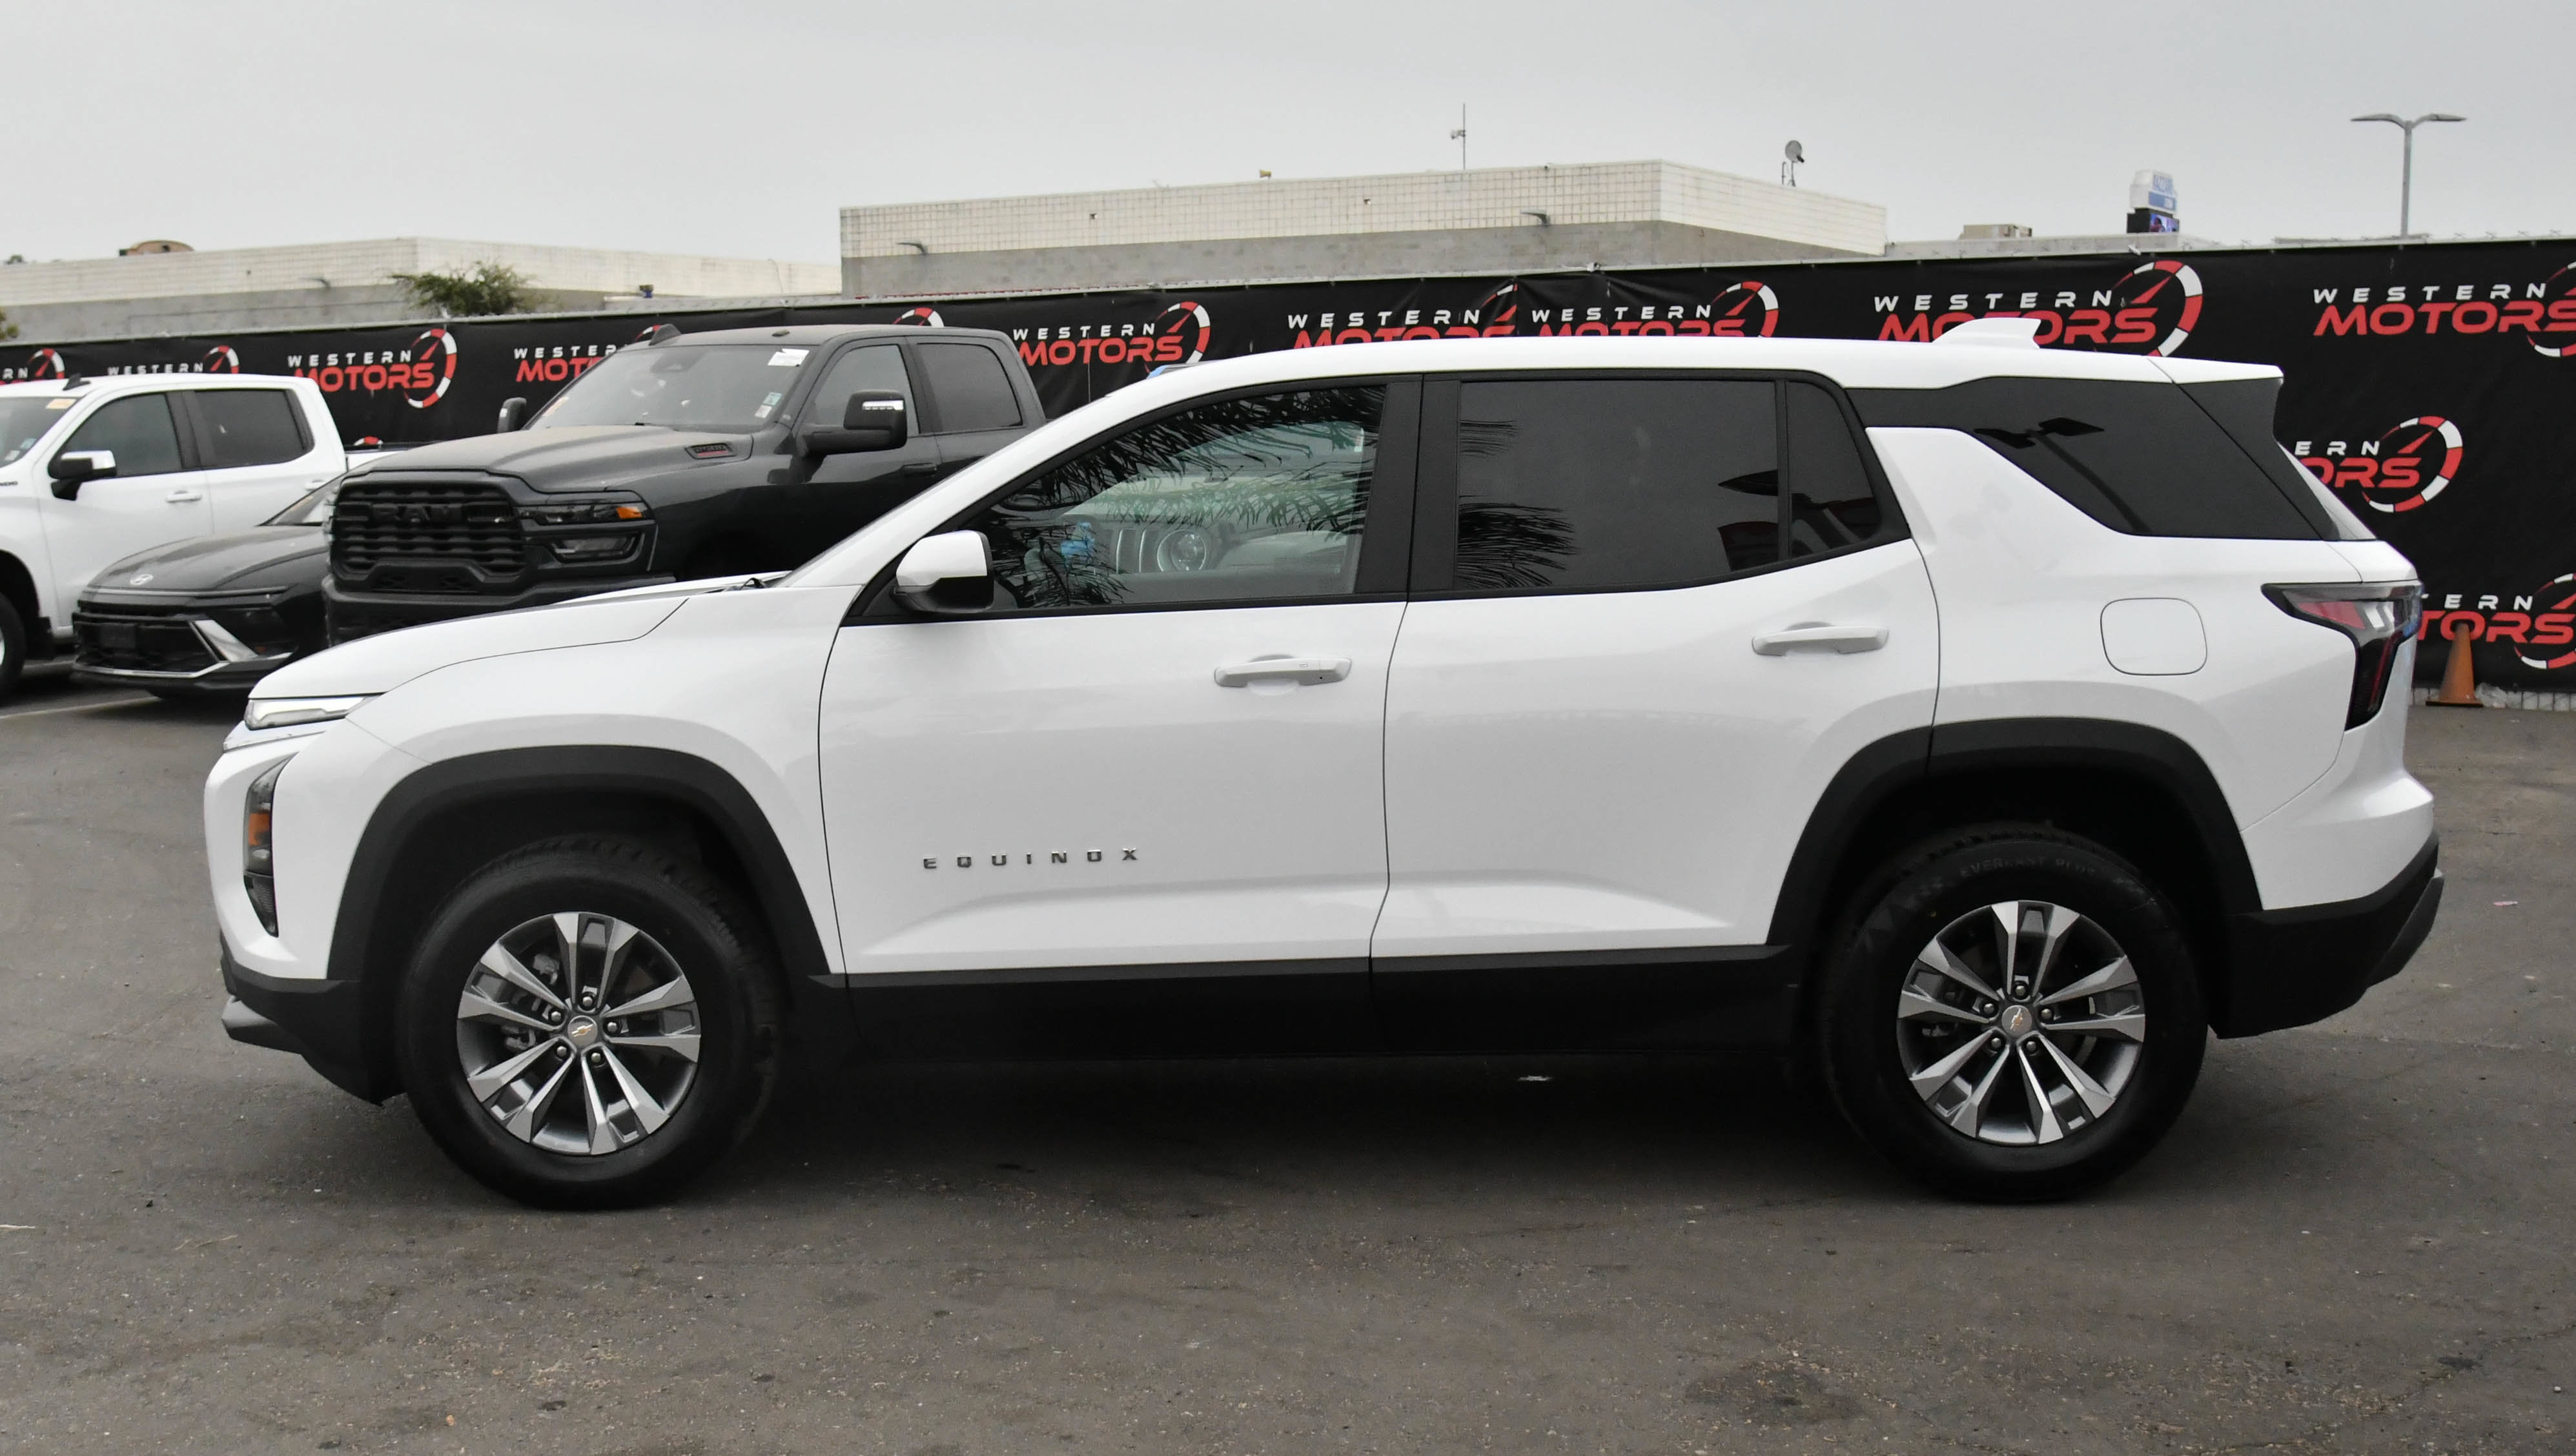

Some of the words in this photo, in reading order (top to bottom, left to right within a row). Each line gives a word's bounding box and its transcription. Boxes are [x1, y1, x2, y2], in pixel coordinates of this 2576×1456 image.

[1874, 290, 2112, 312] WESTERN
[2313, 283, 2546, 303] WESTERN
[1288, 309, 1480, 329] WESTERN
[1532, 305, 1711, 323] WESTERN
[2313, 300, 2576, 336] MOTORS
[1013, 323, 1155, 341] WESTERN
[1878, 308, 2152, 345] MORS
[288, 350, 411, 367] WESTERN
[1019, 336, 1183, 366] MOTORS
[107, 362, 203, 376] WESTERN
[923, 847, 1138, 869] EQUINOX
